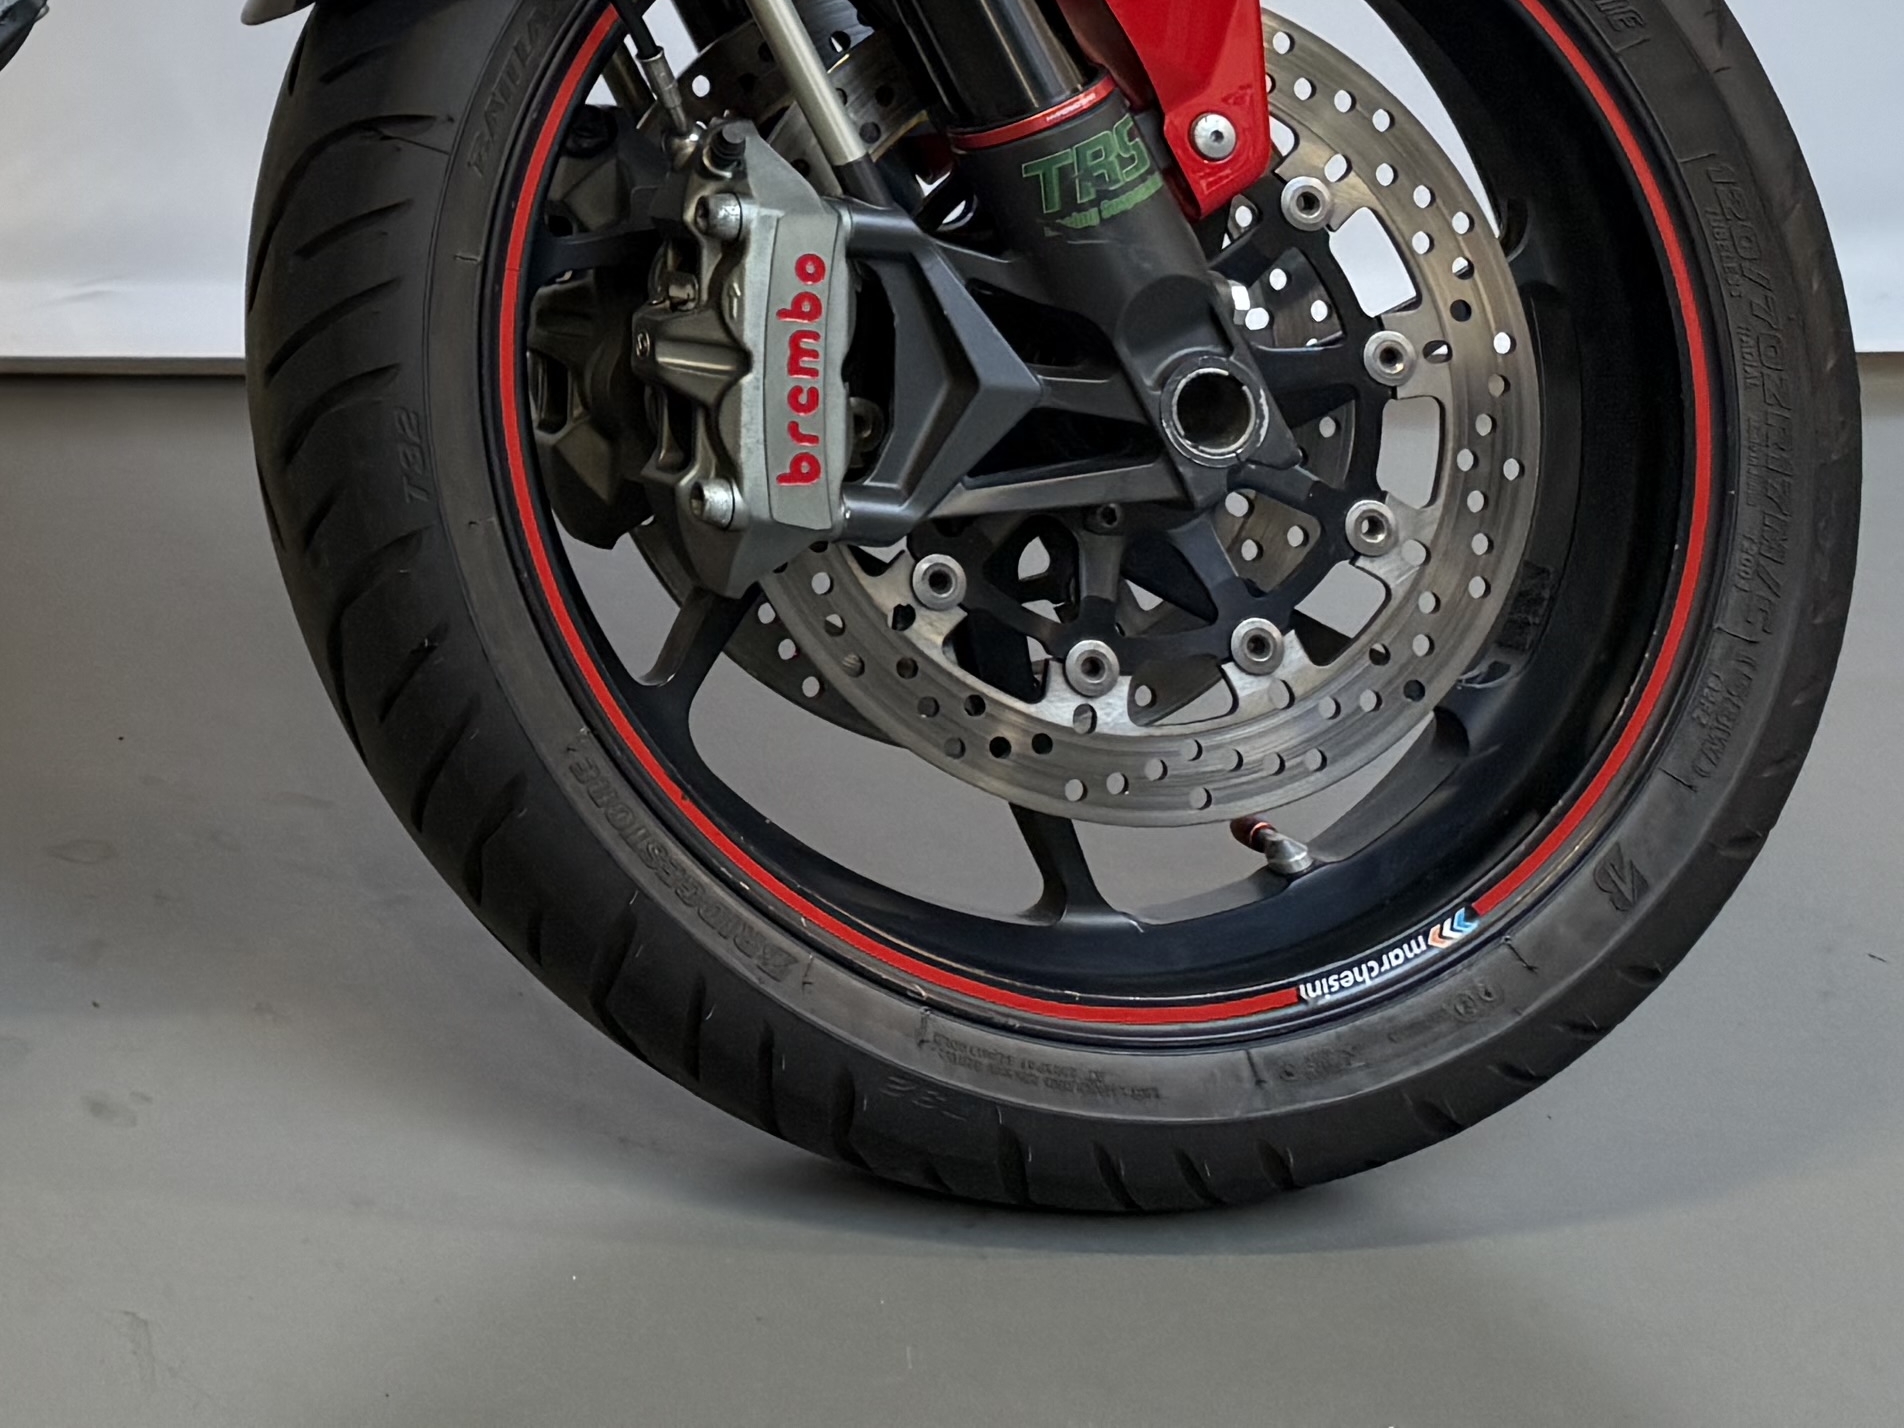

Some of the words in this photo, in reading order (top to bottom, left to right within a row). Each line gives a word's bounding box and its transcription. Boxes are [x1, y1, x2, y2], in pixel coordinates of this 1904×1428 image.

[1021, 113, 1150, 214] TRS
[776, 251, 827, 488] brembo
[390, 404, 433, 509] T32
